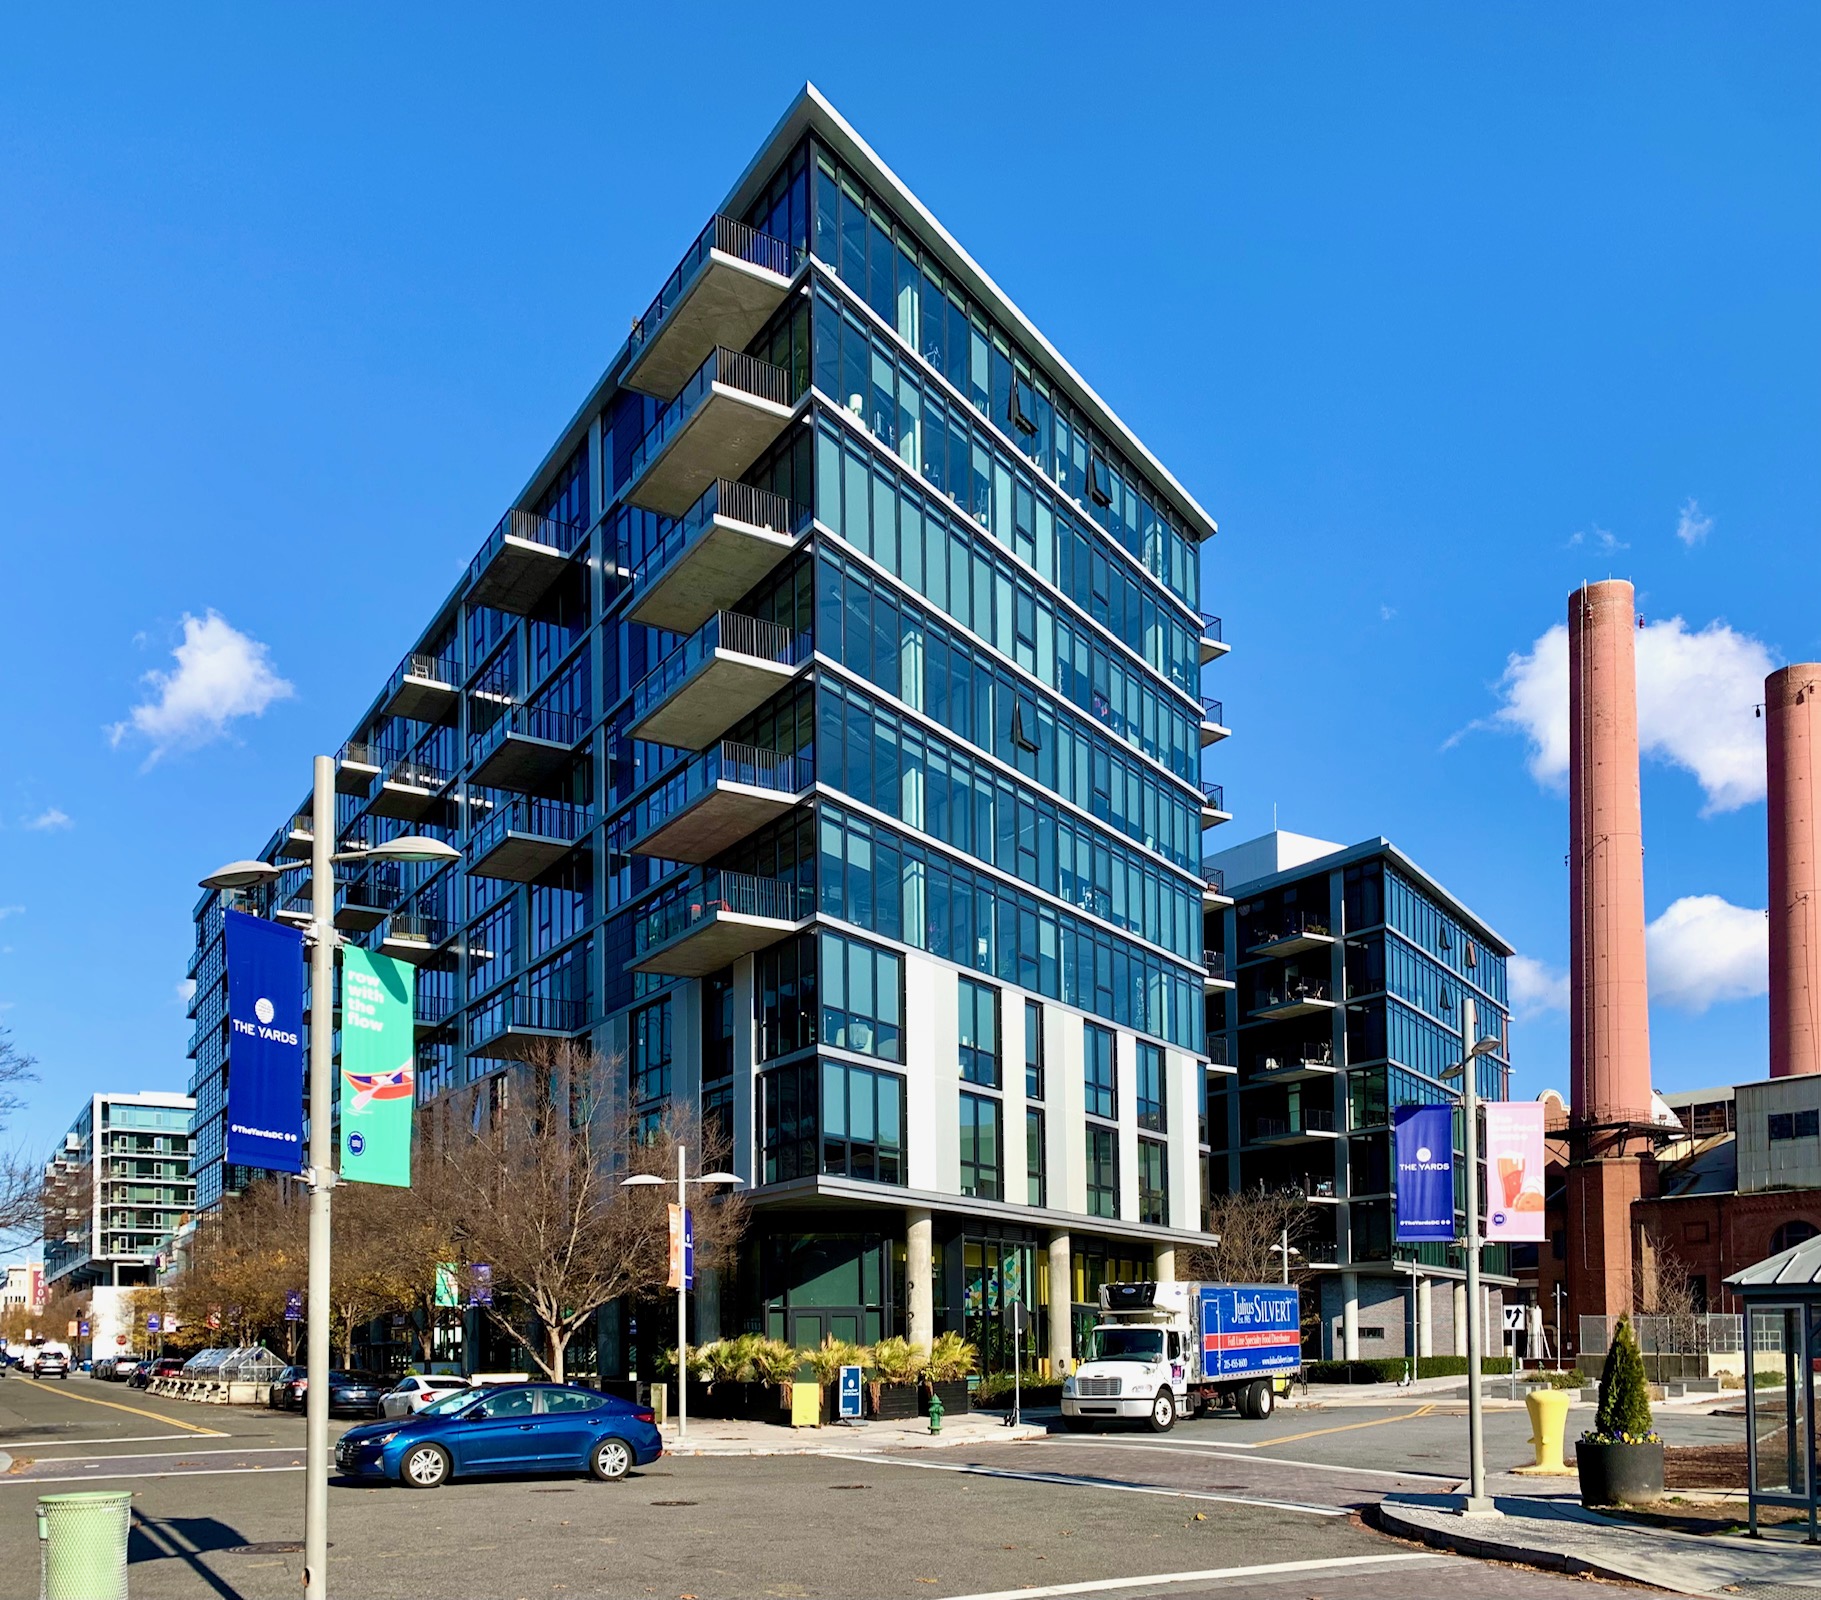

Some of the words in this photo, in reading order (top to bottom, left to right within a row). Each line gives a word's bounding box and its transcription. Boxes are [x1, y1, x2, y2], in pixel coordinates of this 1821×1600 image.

[347, 970, 380, 986] row
[347, 983, 385, 1004] with
[347, 997, 376, 1015] the
[347, 1011, 384, 1032] flow
[232, 1018, 256, 1037] THE
[257, 1025, 298, 1046] YARDS
[231, 1124, 284, 1140] @TheYardsDC
[1399, 1163, 1417, 1171] THE
[1418, 1162, 1450, 1171] YARDS
[1231, 1290, 1255, 1324] Julius
[1254, 1294, 1292, 1323] SILVERT
[1227, 1335, 1236, 1347] Full
[1236, 1335, 1245, 1346] Line
[1245, 1334, 1262, 1348] Specialty
[1262, 1334, 1271, 1345] Food
